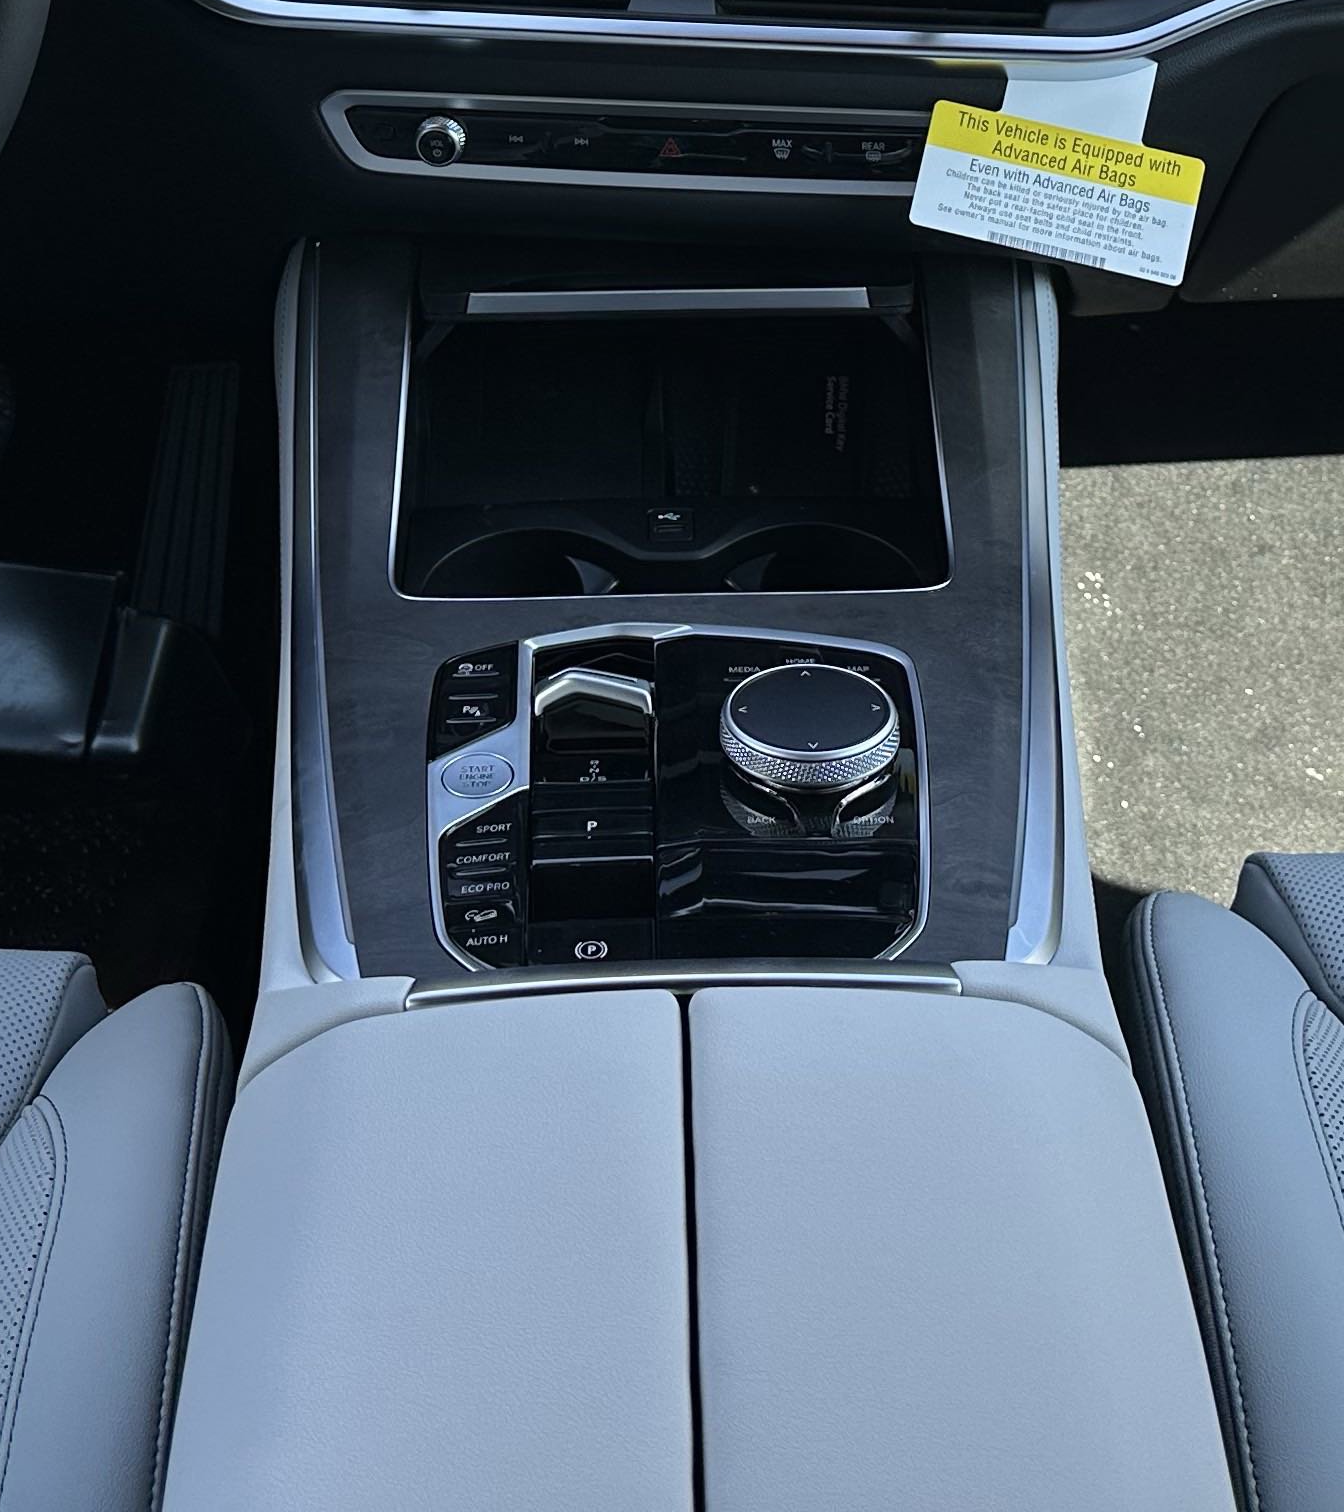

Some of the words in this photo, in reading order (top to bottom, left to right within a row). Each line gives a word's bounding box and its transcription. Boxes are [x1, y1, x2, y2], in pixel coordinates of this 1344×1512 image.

[772, 139, 793, 148] MAX
[861, 142, 885, 151] REAR
[956, 110, 990, 132] This
[993, 119, 1050, 146] Vehicle
[1053, 133, 1068, 150] is
[1070, 137, 1144, 171] Equipped
[1147, 155, 1182, 176] with
[991, 139, 1067, 171] Advanced
[1070, 158, 1095, 177] Air
[1097, 165, 1137, 190] Bags
[968, 158, 1000, 177] Even
[1002, 166, 1031, 185] with
[1032, 173, 1095, 200] Advanced
[1096, 188, 1117, 205] Air
[1117, 193, 1151, 214] Bags
[460, 764, 495, 773] START
[459, 772, 494, 781] ENGINE
[462, 780, 492, 788] STOP
[587, 820, 598, 832] P
[747, 816, 776, 824] BACK
[476, 822, 513, 834] SPORT
[456, 852, 511, 865] COMFORT
[461, 884, 485, 894] ECO
[486, 881, 510, 892] PRO
[465, 935, 497, 947] AUTO
[499, 934, 508, 944] H
